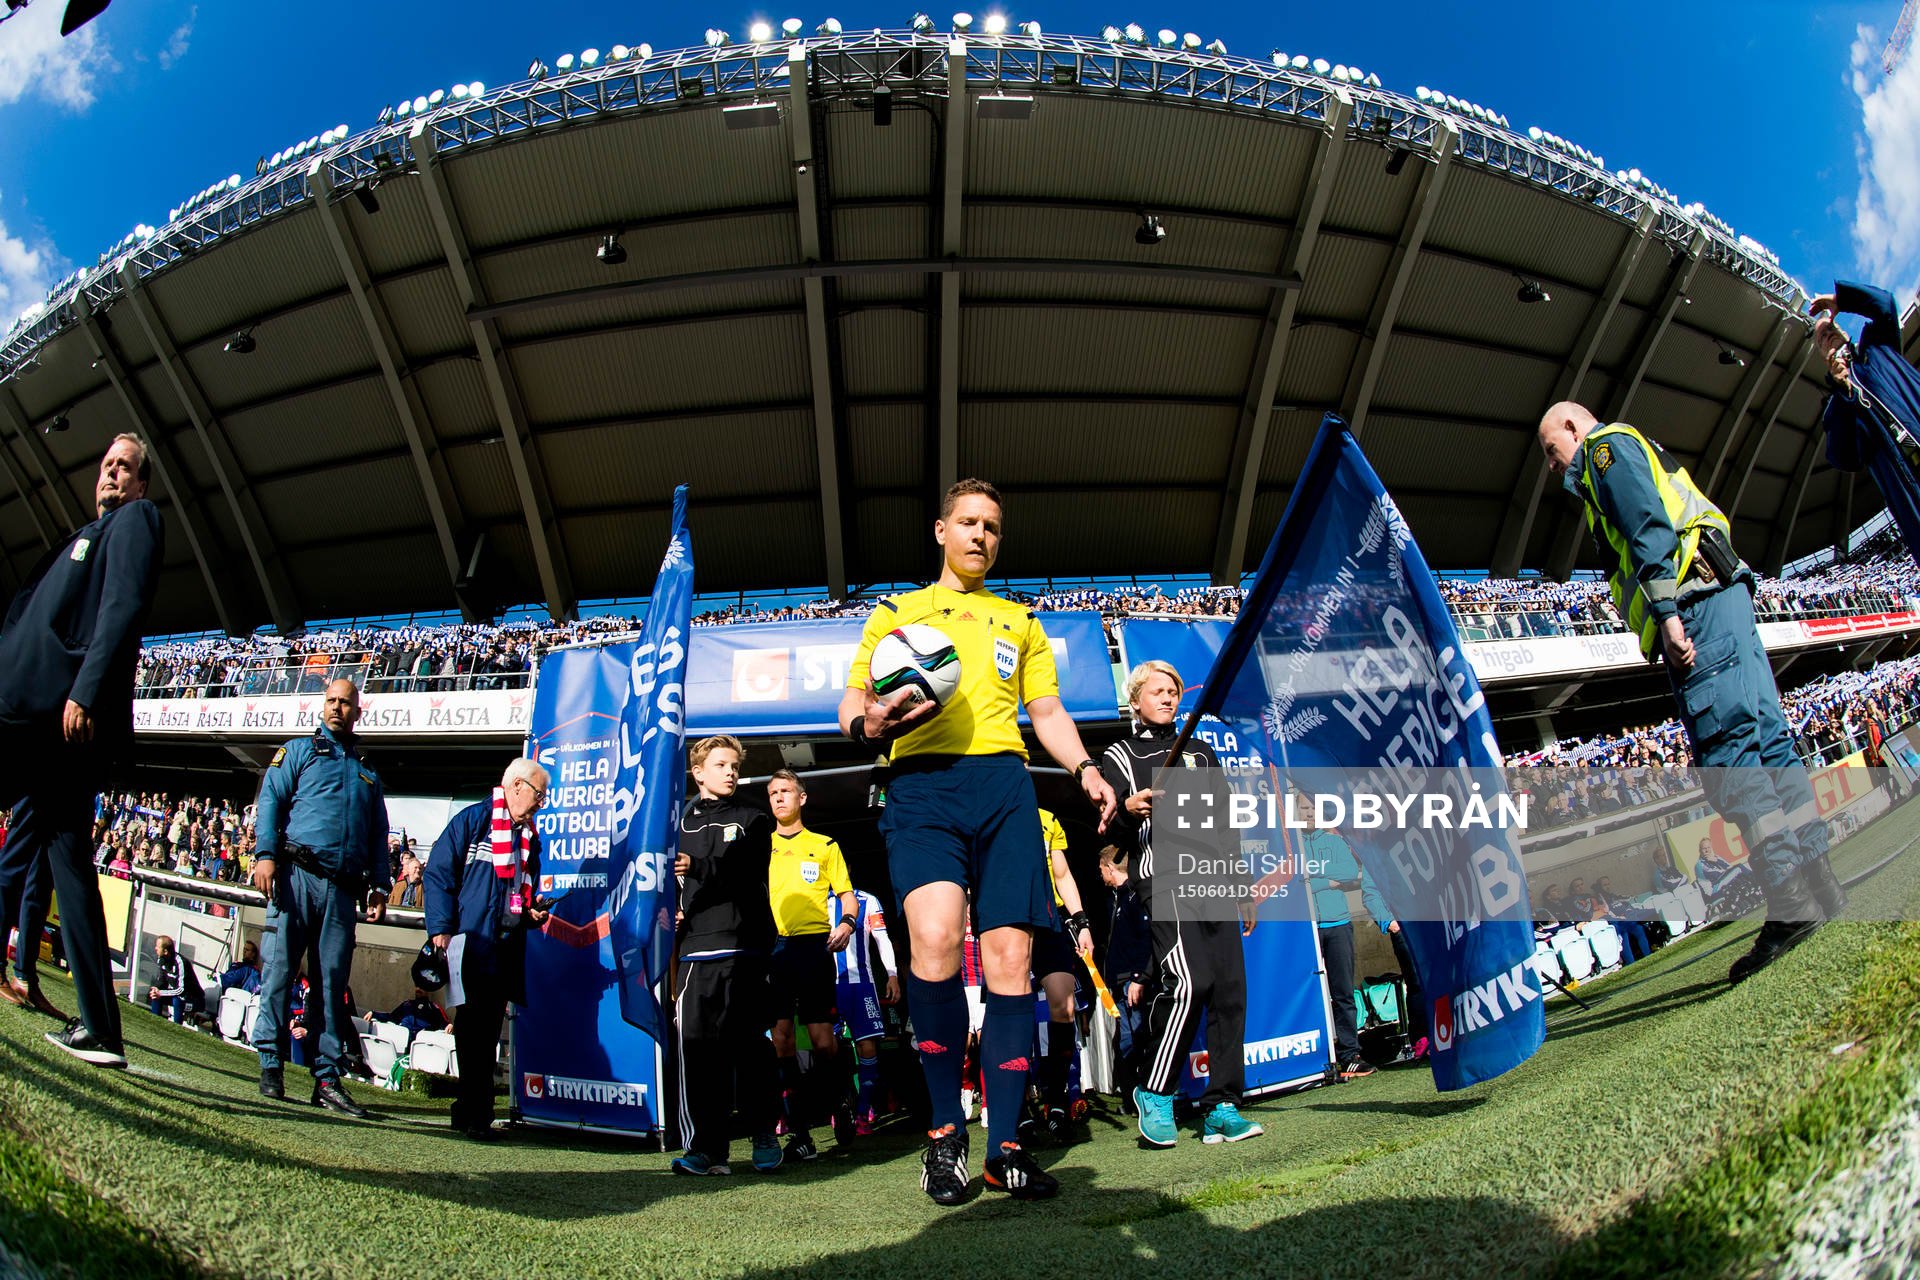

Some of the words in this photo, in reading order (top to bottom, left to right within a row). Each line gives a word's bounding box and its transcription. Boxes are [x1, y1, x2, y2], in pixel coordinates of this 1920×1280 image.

[1287, 585, 1345, 673] VÄLKOMMEN
[1335, 565, 1355, 589] IN
[997, 653, 1014, 667] FIFA
[1480, 644, 1534, 673] higab
[1585, 638, 1628, 662] higab
[1332, 605, 1419, 741] HELA
[134, 711, 152, 726] STA
[157, 711, 190, 726] RASTA
[196, 711, 233, 727] RASTA
[242, 711, 284, 727] RASTA
[295, 711, 325, 727] RAS
[356, 708, 412, 726] RASTA
[426, 707, 490, 726] RASTA
[1352, 646, 1485, 831] SVERIGE
[560, 757, 610, 782] HELA
[541, 783, 616, 810] SVERIGE
[555, 875, 608, 888] STRYKTIPS
[1244, 1031, 1320, 1066] RYKTIPSET
[547, 1077, 645, 1107] STRYKTIPSET
